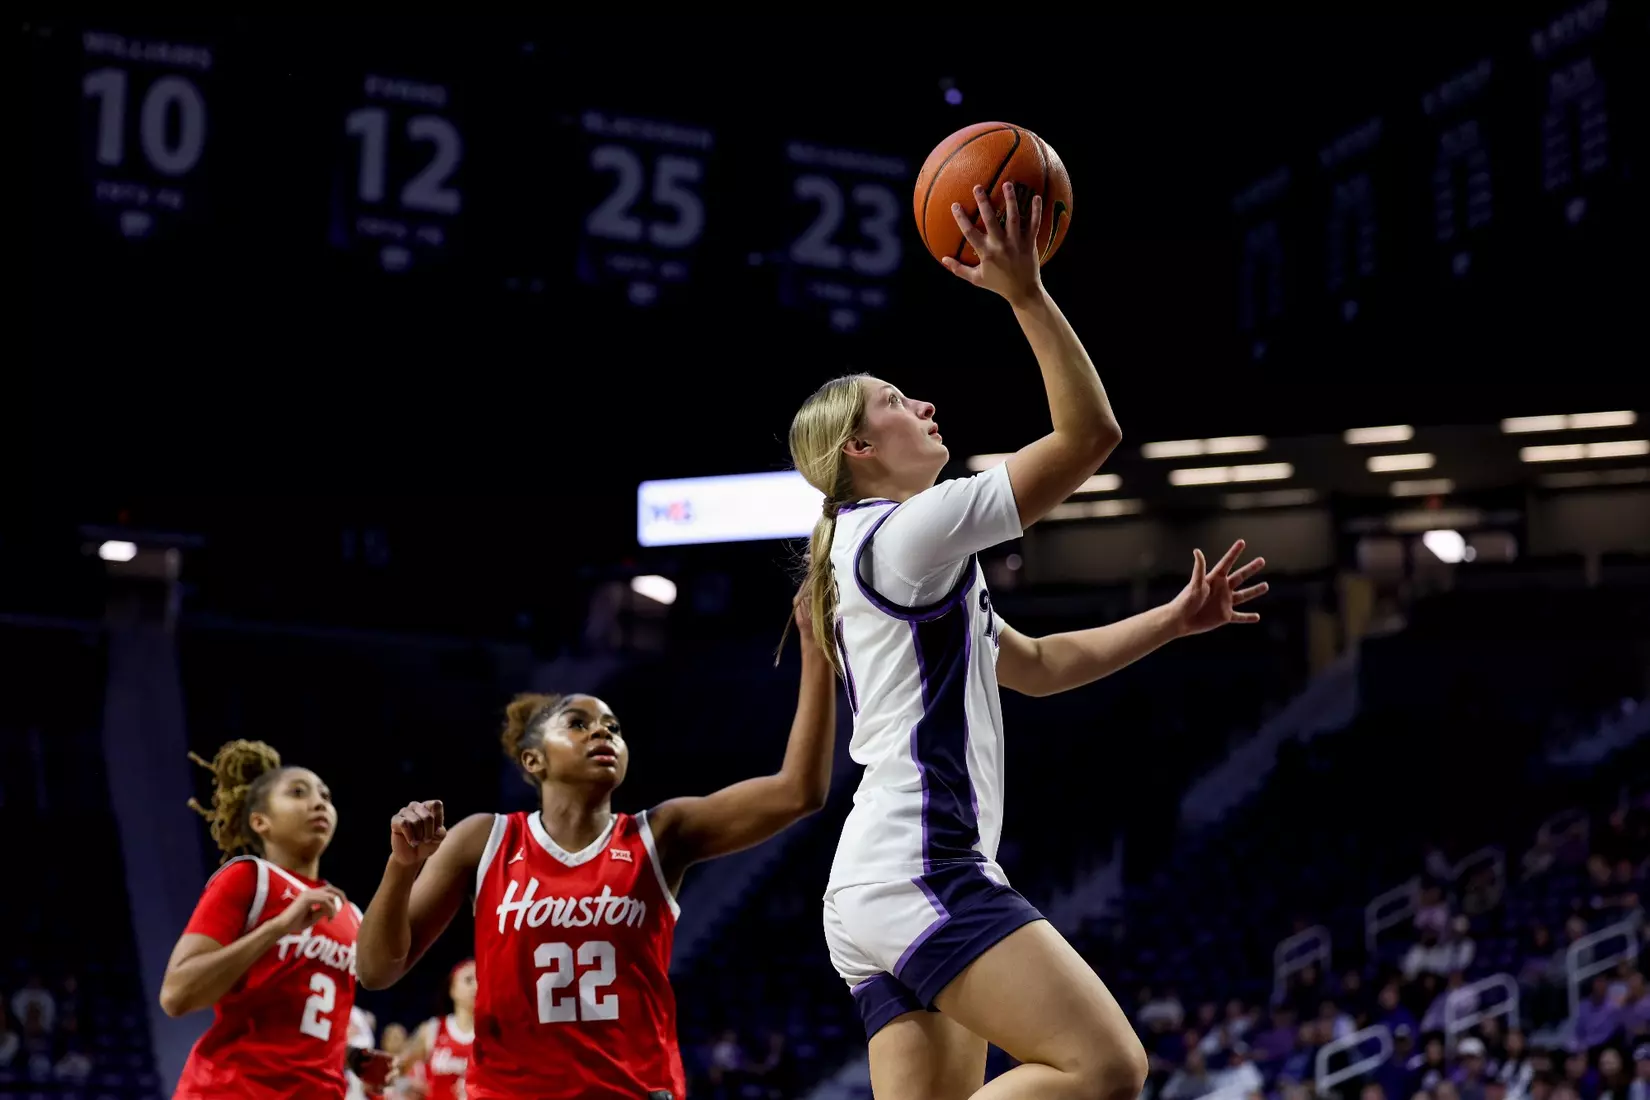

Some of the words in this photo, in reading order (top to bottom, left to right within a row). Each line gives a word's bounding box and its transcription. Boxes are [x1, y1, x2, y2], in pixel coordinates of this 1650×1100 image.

[82, 67, 207, 176] 10
[345, 107, 464, 215] 12
[585, 144, 705, 249] 25
[790, 174, 902, 277] 23
[497, 877, 646, 935] Houston
[299, 972, 337, 1042] 2
[534, 941, 619, 1024] 22
